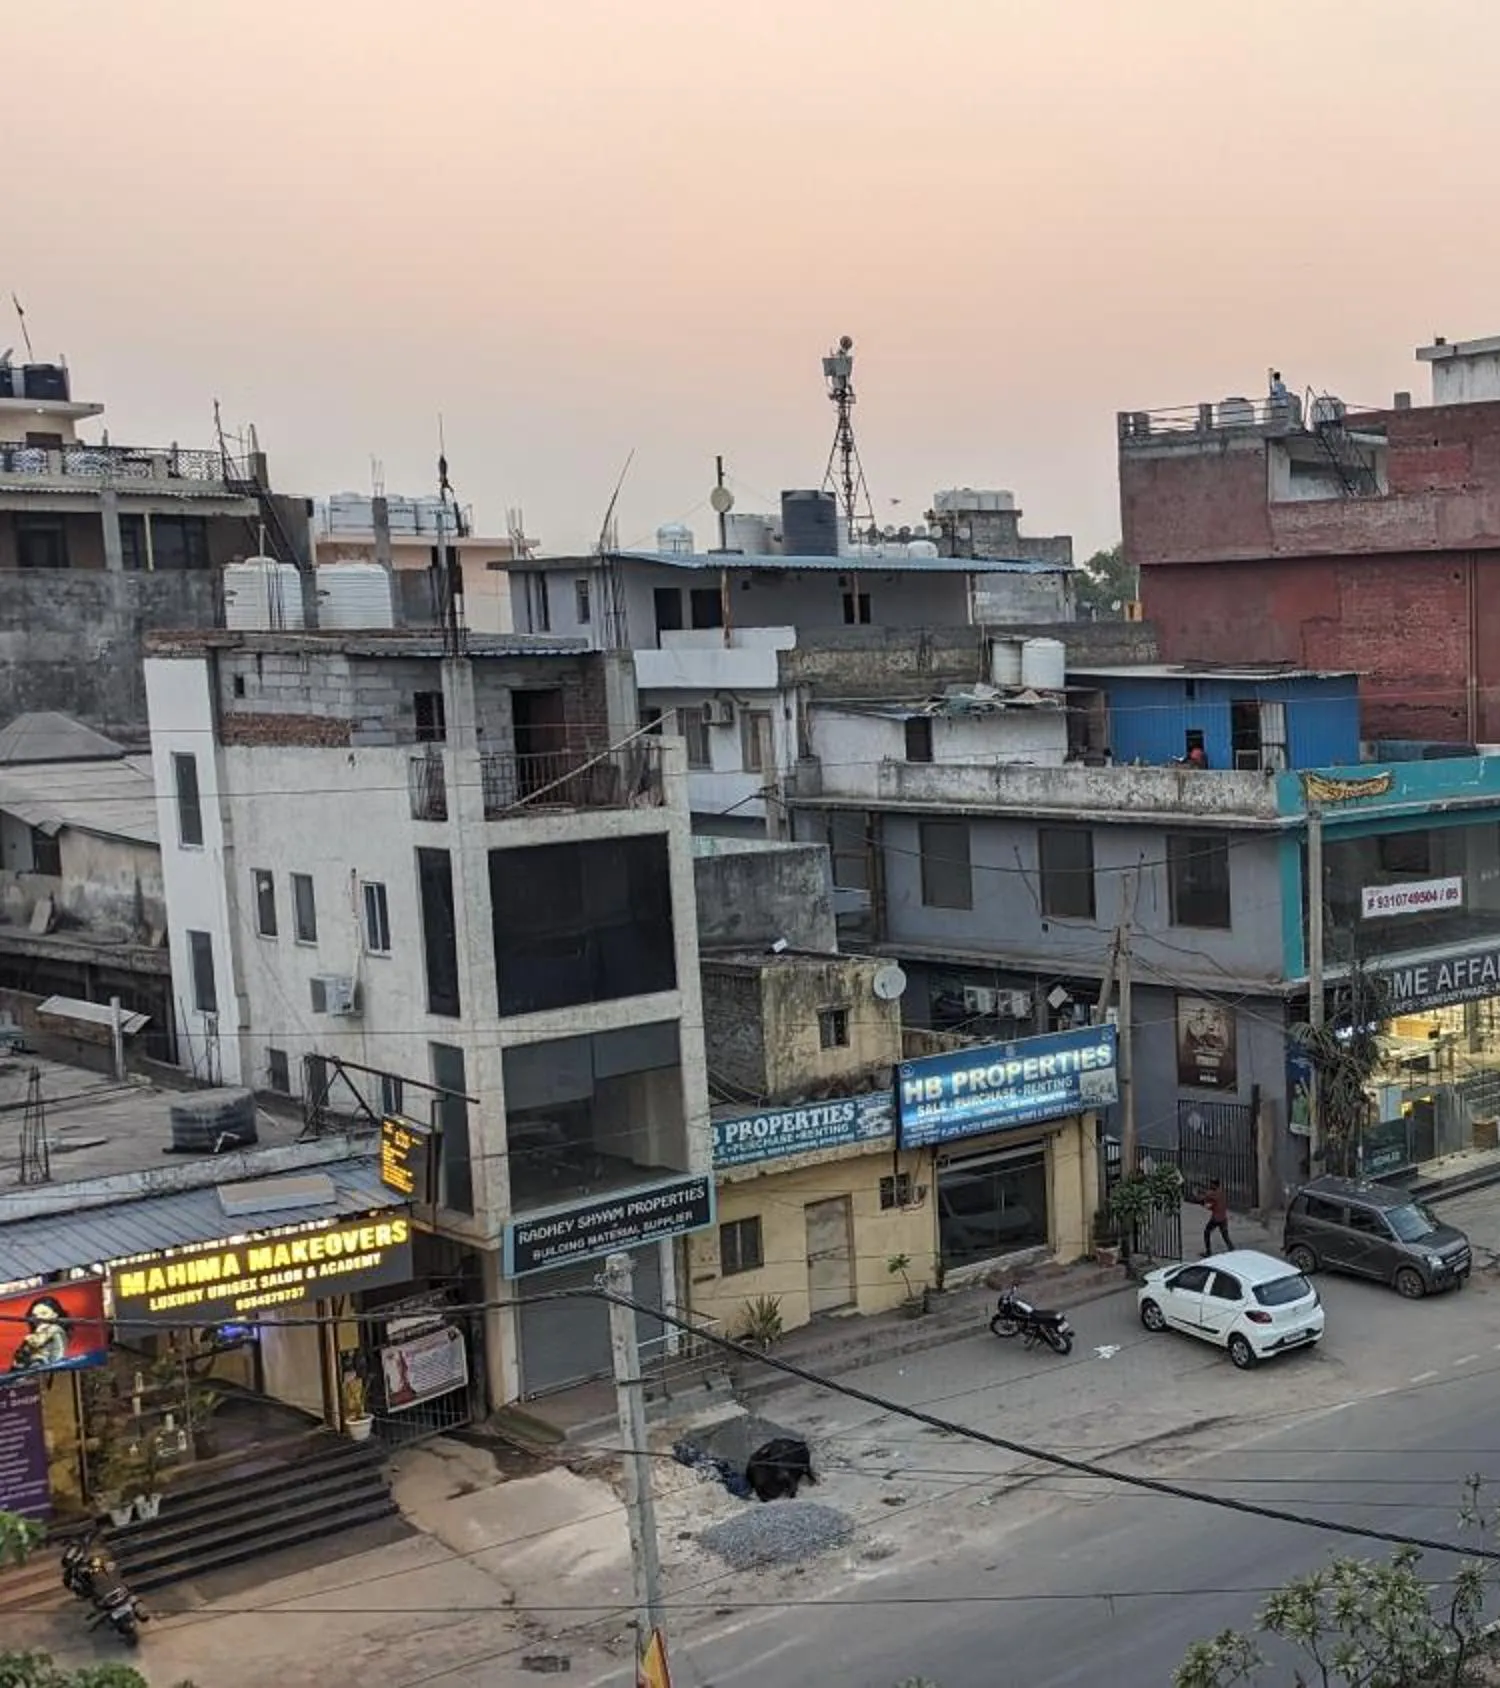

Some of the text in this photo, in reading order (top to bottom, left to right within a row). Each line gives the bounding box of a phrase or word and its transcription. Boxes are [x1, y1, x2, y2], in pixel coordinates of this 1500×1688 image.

[903, 1044, 1113, 1104] HB PROPERTIES
[725, 1102, 855, 1142] PROPERTIES
[518, 1218, 575, 1245] RADHEY
[577, 1206, 625, 1230] SHYAM
[627, 1185, 705, 1217] PROPERTIES
[532, 1239, 585, 1261] BUILDING
[588, 1225, 641, 1246] MATERIAL
[643, 1210, 694, 1233] SUPPLIER
[119, 1219, 409, 1297] MAHIMA MAKEOVERS
[149, 1252, 382, 1312] LUXURY UNISEX SALON & ACADEMY
